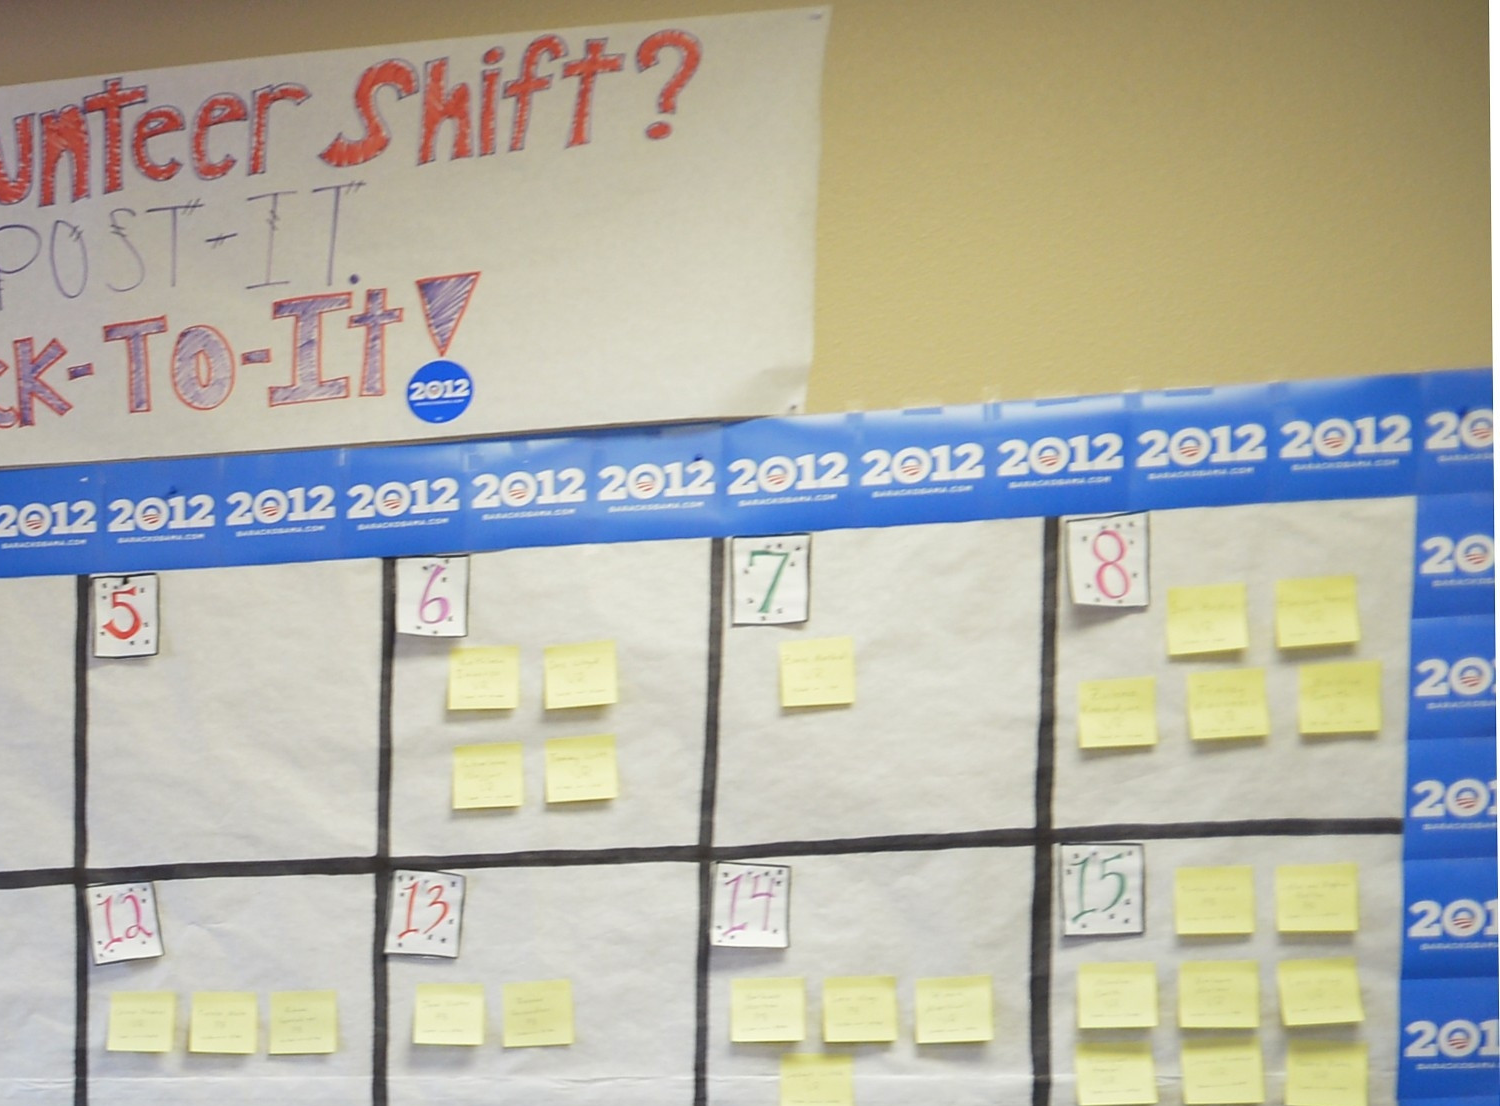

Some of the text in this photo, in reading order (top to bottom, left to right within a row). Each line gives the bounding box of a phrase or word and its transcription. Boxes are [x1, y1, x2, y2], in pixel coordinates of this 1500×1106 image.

[409, 378, 470, 401] 2012
[997, 433, 1124, 478] 2012
[1136, 423, 1267, 468] 2012
[1280, 415, 1411, 460] 2012
[598, 460, 716, 501] 2012
[727, 451, 849, 495] 2012
[861, 442, 985, 485] 2012
[226, 485, 336, 525] 2012
[347, 477, 460, 517] 2012
[472, 467, 586, 508] 2012
[108, 494, 215, 531] 2012
[749, 550, 790, 614] 7
[1092, 529, 1132, 600] 8
[101, 585, 144, 642] 5
[418, 564, 452, 625] 6
[396, 881, 451, 940] 13
[723, 873, 776, 936] 14
[1071, 854, 1127, 922] 15
[99, 892, 154, 950] 12
